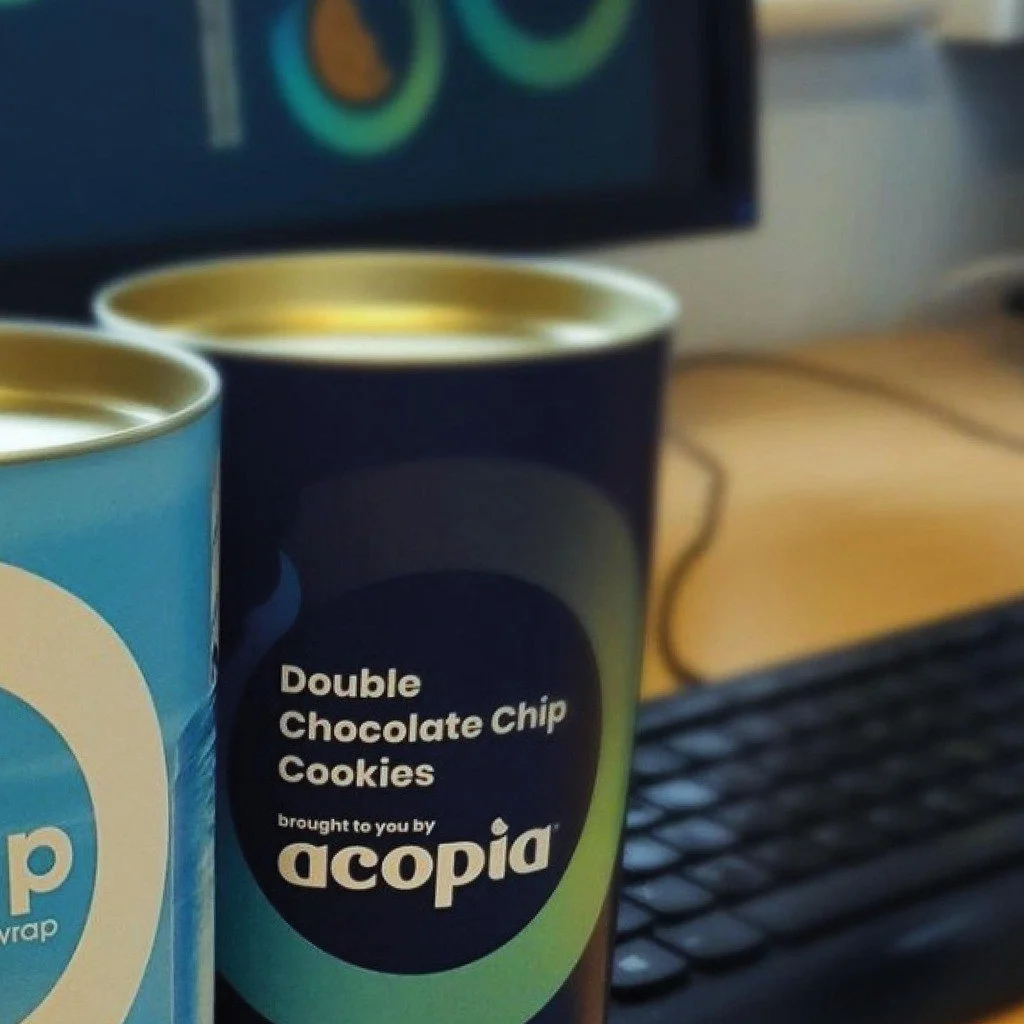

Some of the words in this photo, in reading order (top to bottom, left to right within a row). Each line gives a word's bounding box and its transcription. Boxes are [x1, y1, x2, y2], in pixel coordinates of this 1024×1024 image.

[280, 664, 422, 699] Double
[279, 710, 484, 744] Chocolate
[490, 695, 568, 735] Chip
[278, 754, 435, 788] Cookies
[278, 813, 350, 835] brought
[352, 819, 372, 834] to
[375, 821, 409, 837] you
[413, 818, 437, 836] by
